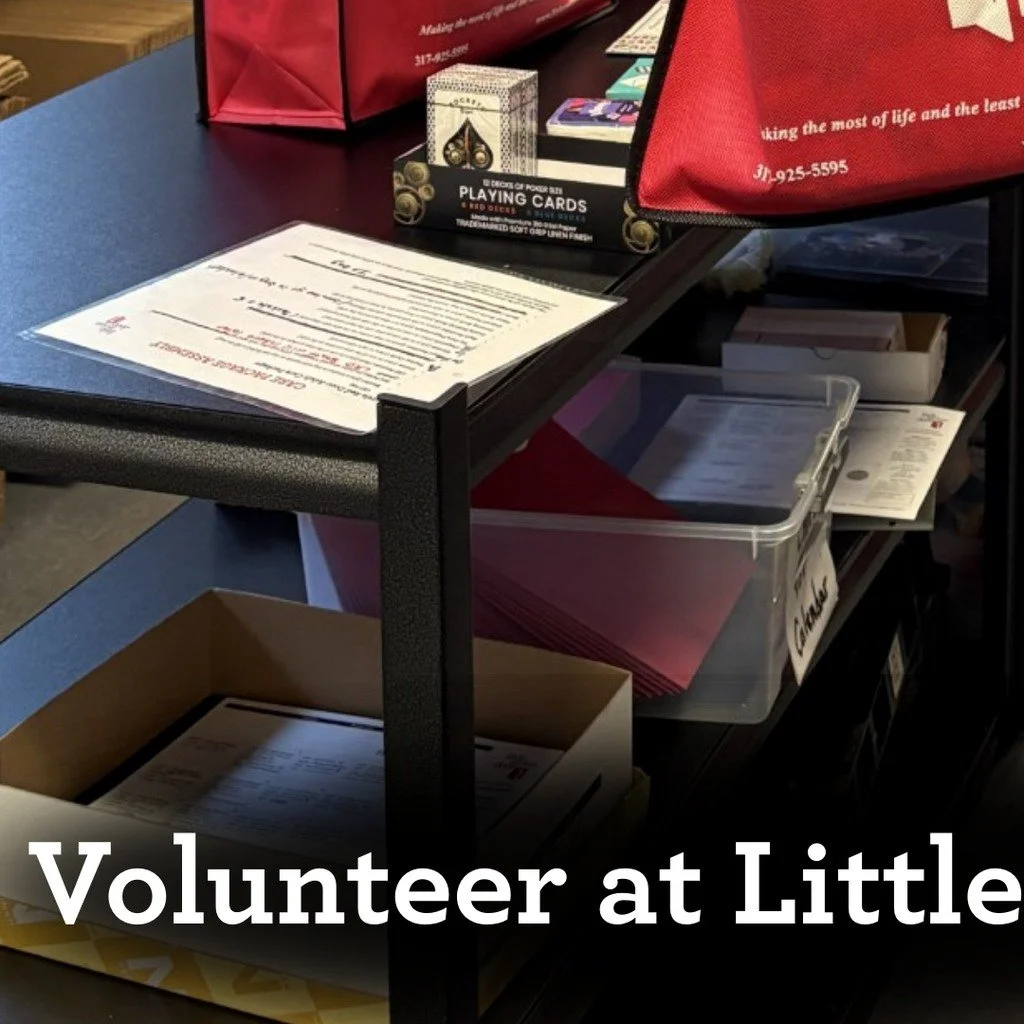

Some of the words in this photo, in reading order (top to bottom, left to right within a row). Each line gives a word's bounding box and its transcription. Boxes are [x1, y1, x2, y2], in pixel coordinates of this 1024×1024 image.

[418, 23, 453, 37] Making
[802, 120, 827, 136] the
[831, 115, 868, 132] most
[871, 110, 890, 129] of
[892, 107, 917, 128] life
[921, 103, 951, 122] and
[954, 101, 980, 118] the
[984, 95, 1021, 114] least
[459, 185, 527, 206] PLAYING
[532, 193, 587, 213] CARDS
